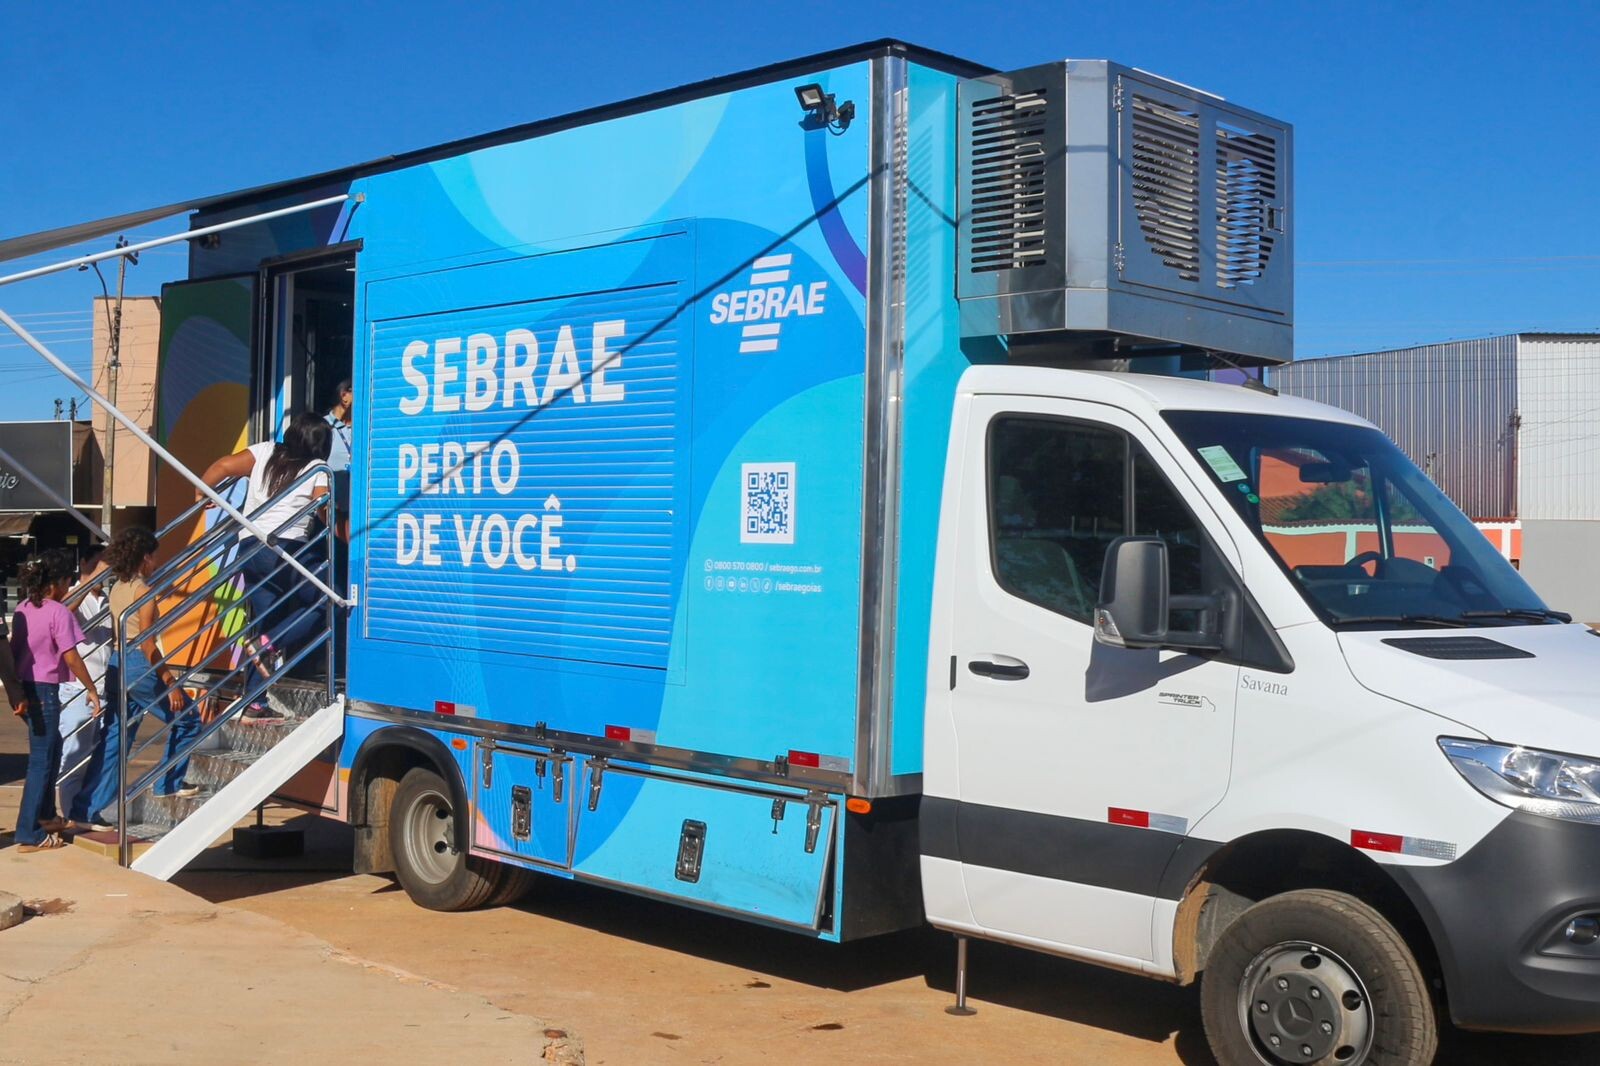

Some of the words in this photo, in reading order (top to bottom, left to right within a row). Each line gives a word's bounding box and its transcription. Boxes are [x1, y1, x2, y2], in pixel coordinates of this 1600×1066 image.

[709, 281, 828, 325] SEBRAE
[398, 319, 626, 416] SEBRAE
[397, 439, 520, 495] PERTO
[396, 513, 442, 566] DE
[453, 493, 577, 572] VOCÊ.
[714, 561, 732, 571] 0800
[732, 561, 745, 571] 570
[746, 562, 764, 572] 0800
[1158, 692, 1200, 700] SPRINTER
[1241, 674, 1288, 696] Savana
